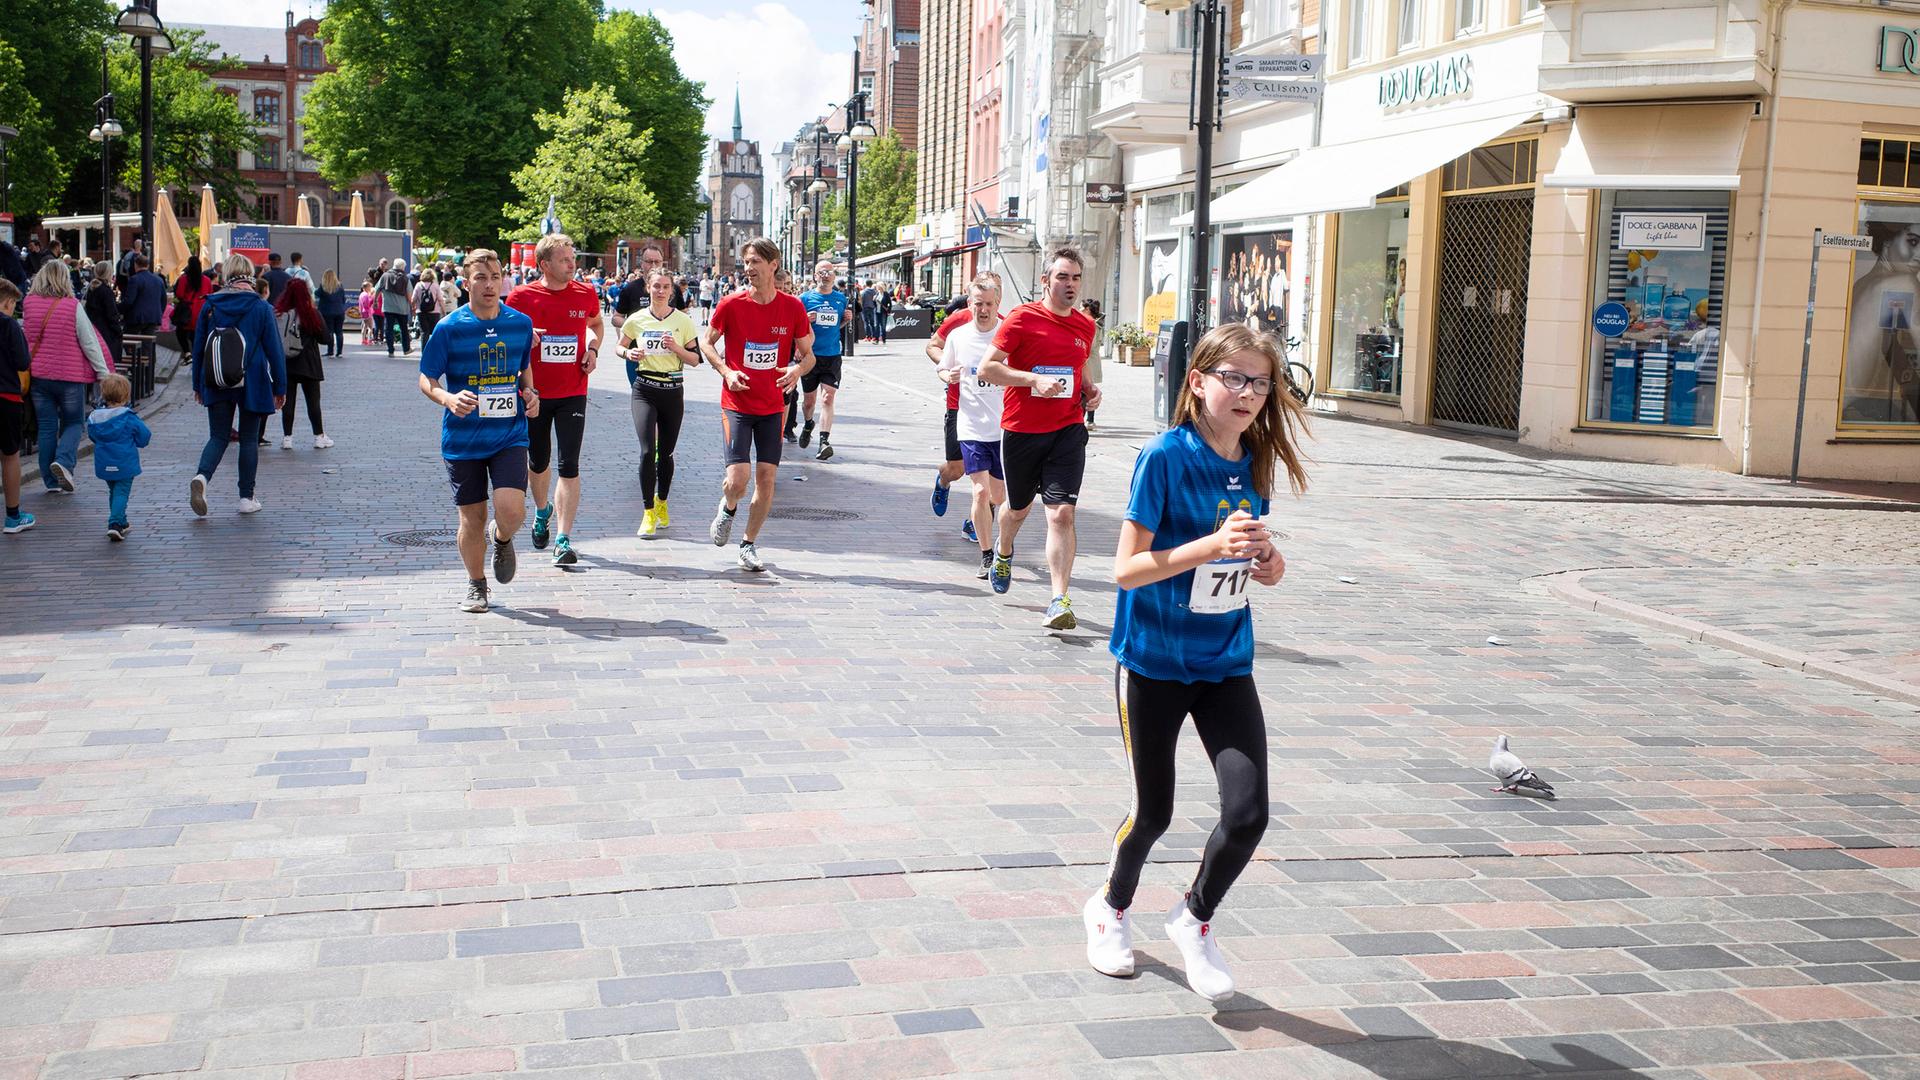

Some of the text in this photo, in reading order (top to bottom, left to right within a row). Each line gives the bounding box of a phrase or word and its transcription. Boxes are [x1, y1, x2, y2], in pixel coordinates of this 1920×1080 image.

[1379, 53, 1470, 107] DOUGLAS
[1657, 222, 1697, 230] GABBANA
[1823, 235, 1870, 248] Eselföterstraße
[821, 314, 835, 322] 946
[544, 345, 576, 356] 1322
[747, 352, 776, 363] 1323
[487, 397, 513, 410] 726
[1211, 569, 1249, 597] 717
